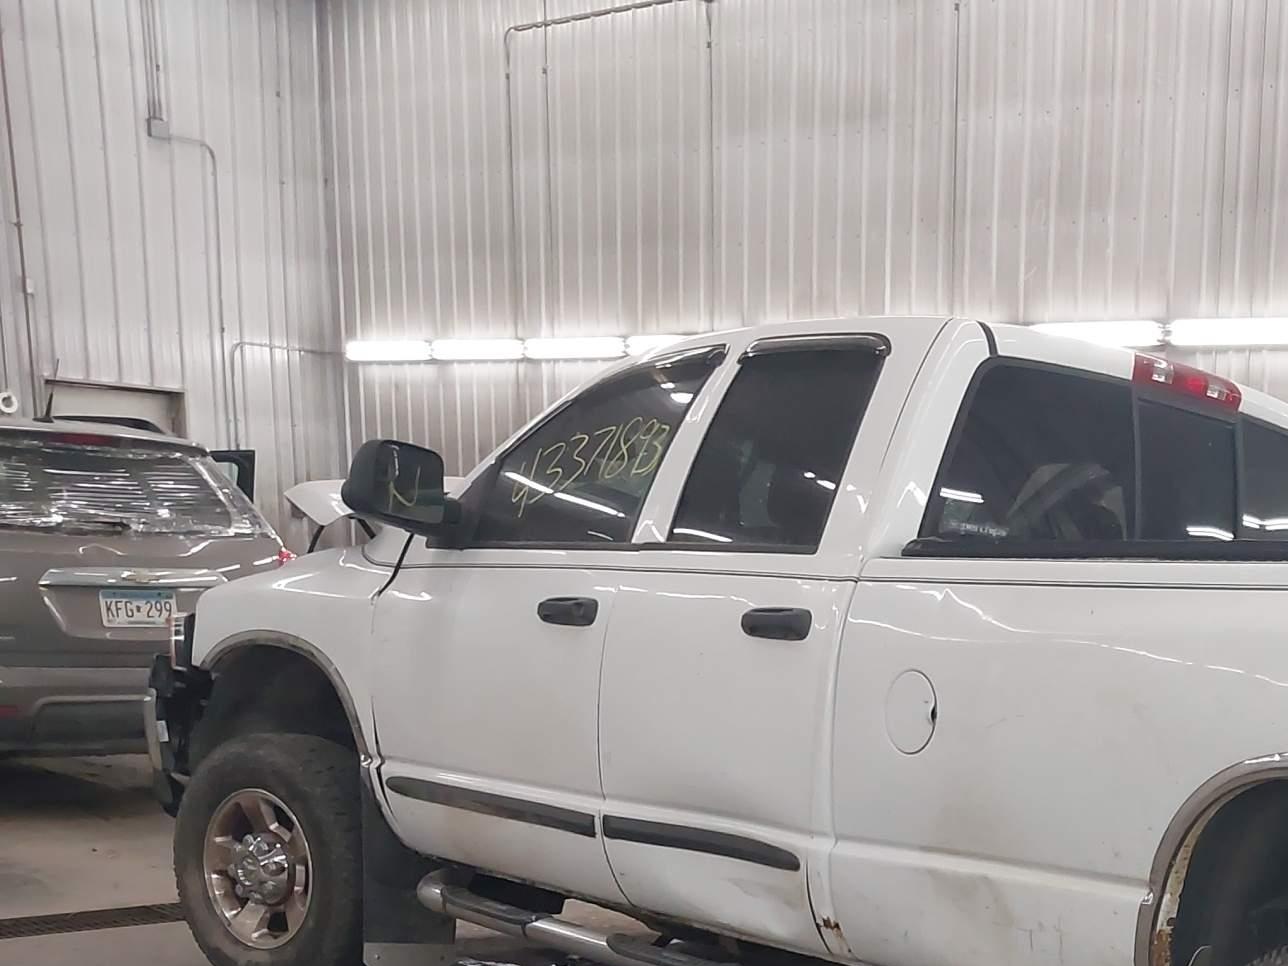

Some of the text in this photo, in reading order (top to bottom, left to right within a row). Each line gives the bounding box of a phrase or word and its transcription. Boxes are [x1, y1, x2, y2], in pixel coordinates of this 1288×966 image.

[511, 416, 671, 518] 43371893
[105, 600, 172, 618] KFG 299
